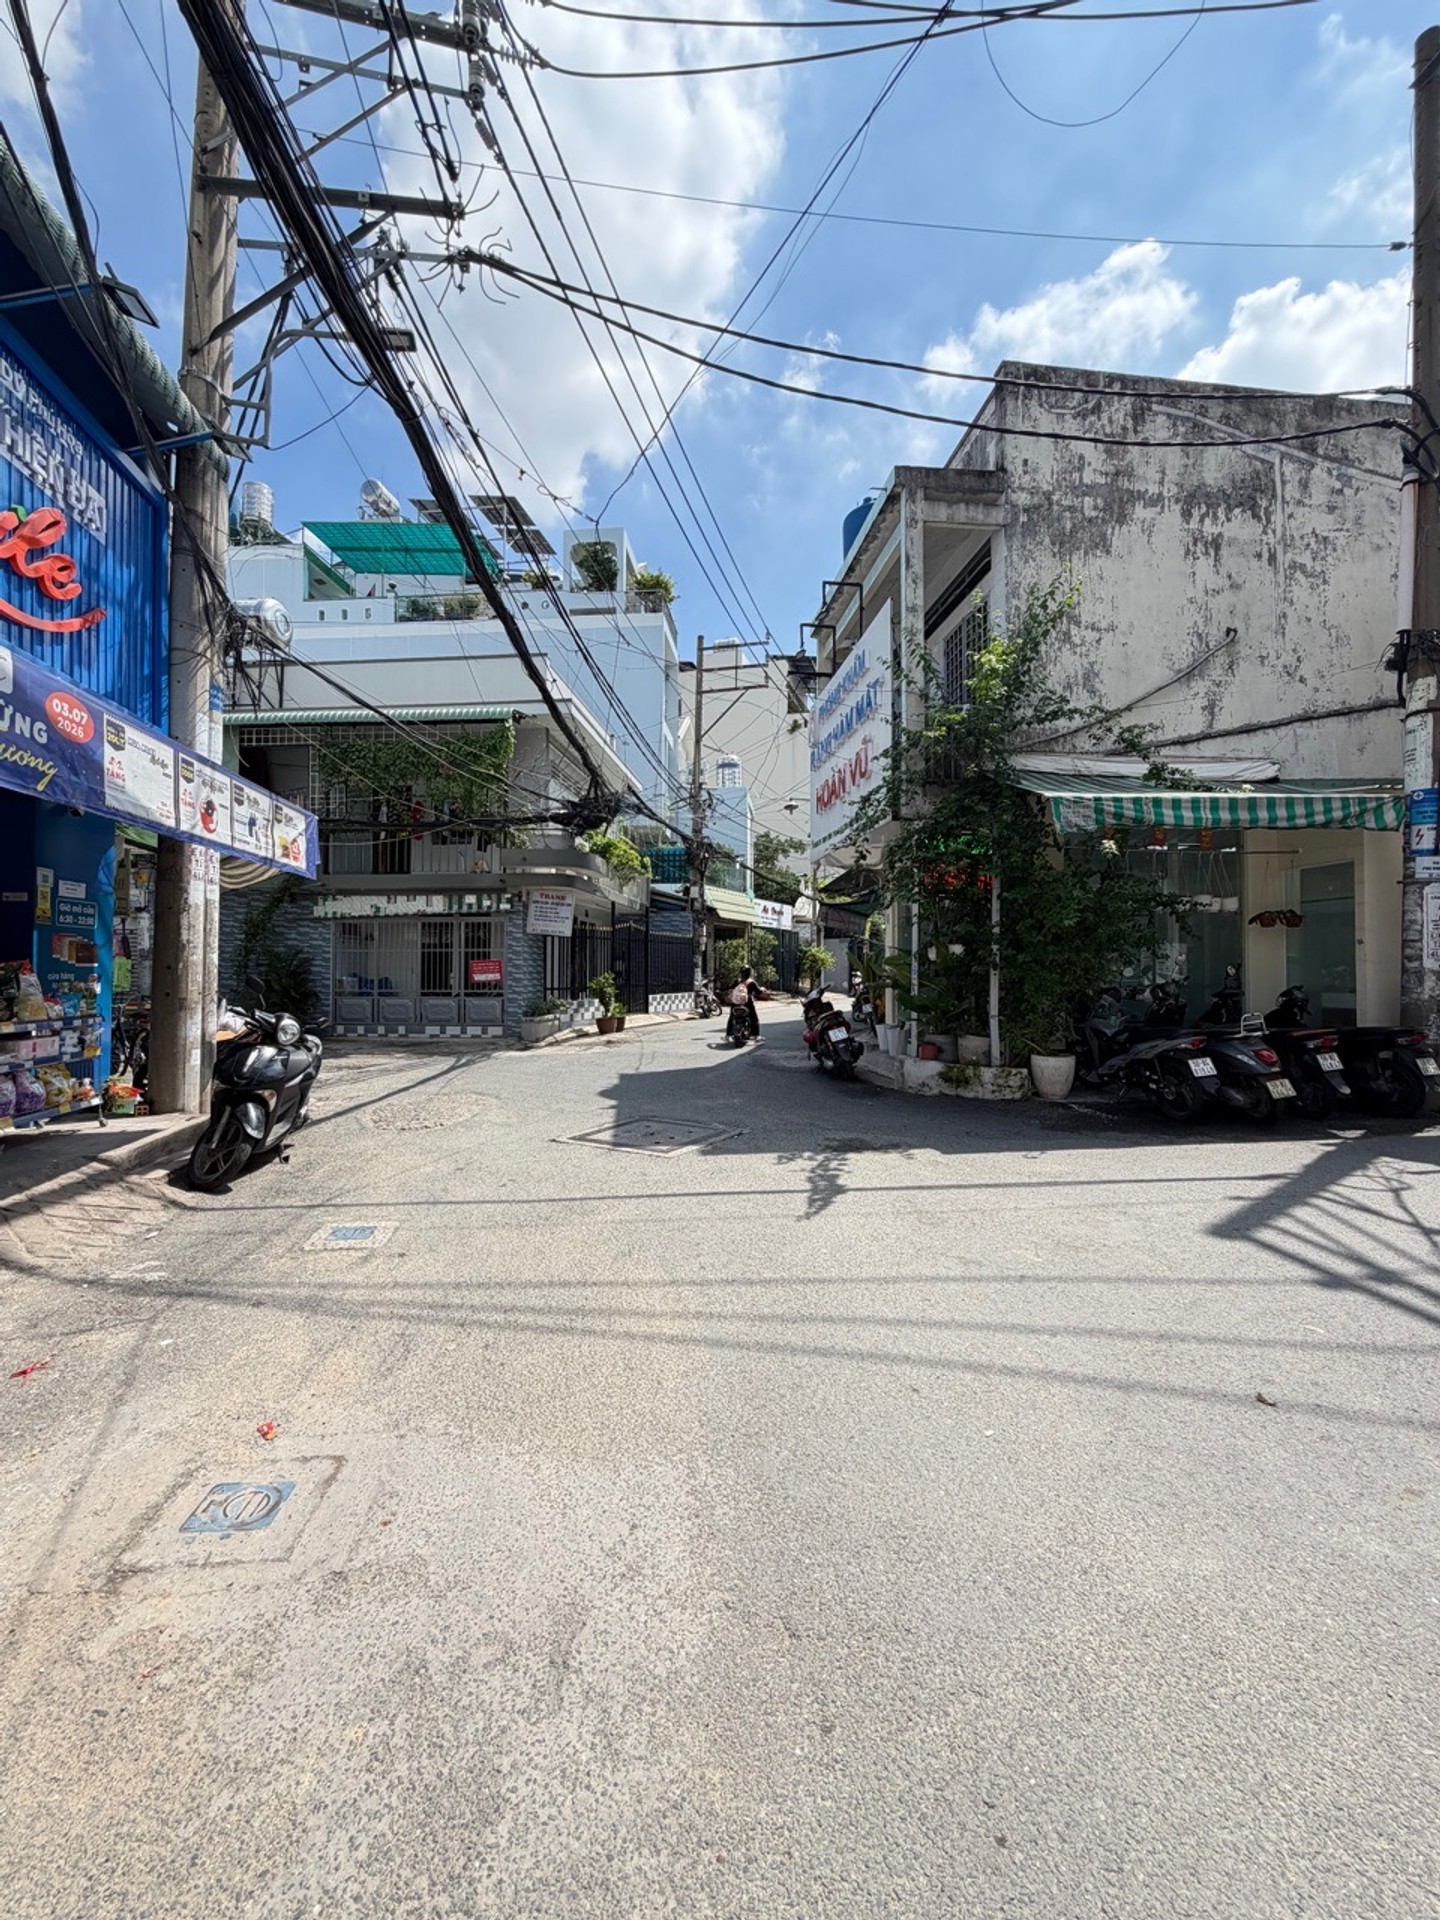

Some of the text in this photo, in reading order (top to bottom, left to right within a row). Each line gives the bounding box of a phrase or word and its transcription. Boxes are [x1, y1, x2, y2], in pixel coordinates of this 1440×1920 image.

[52, 698, 89, 725] 03.07
[57, 716, 85, 738] 2026
[816, 767, 846, 815] HOÀN
